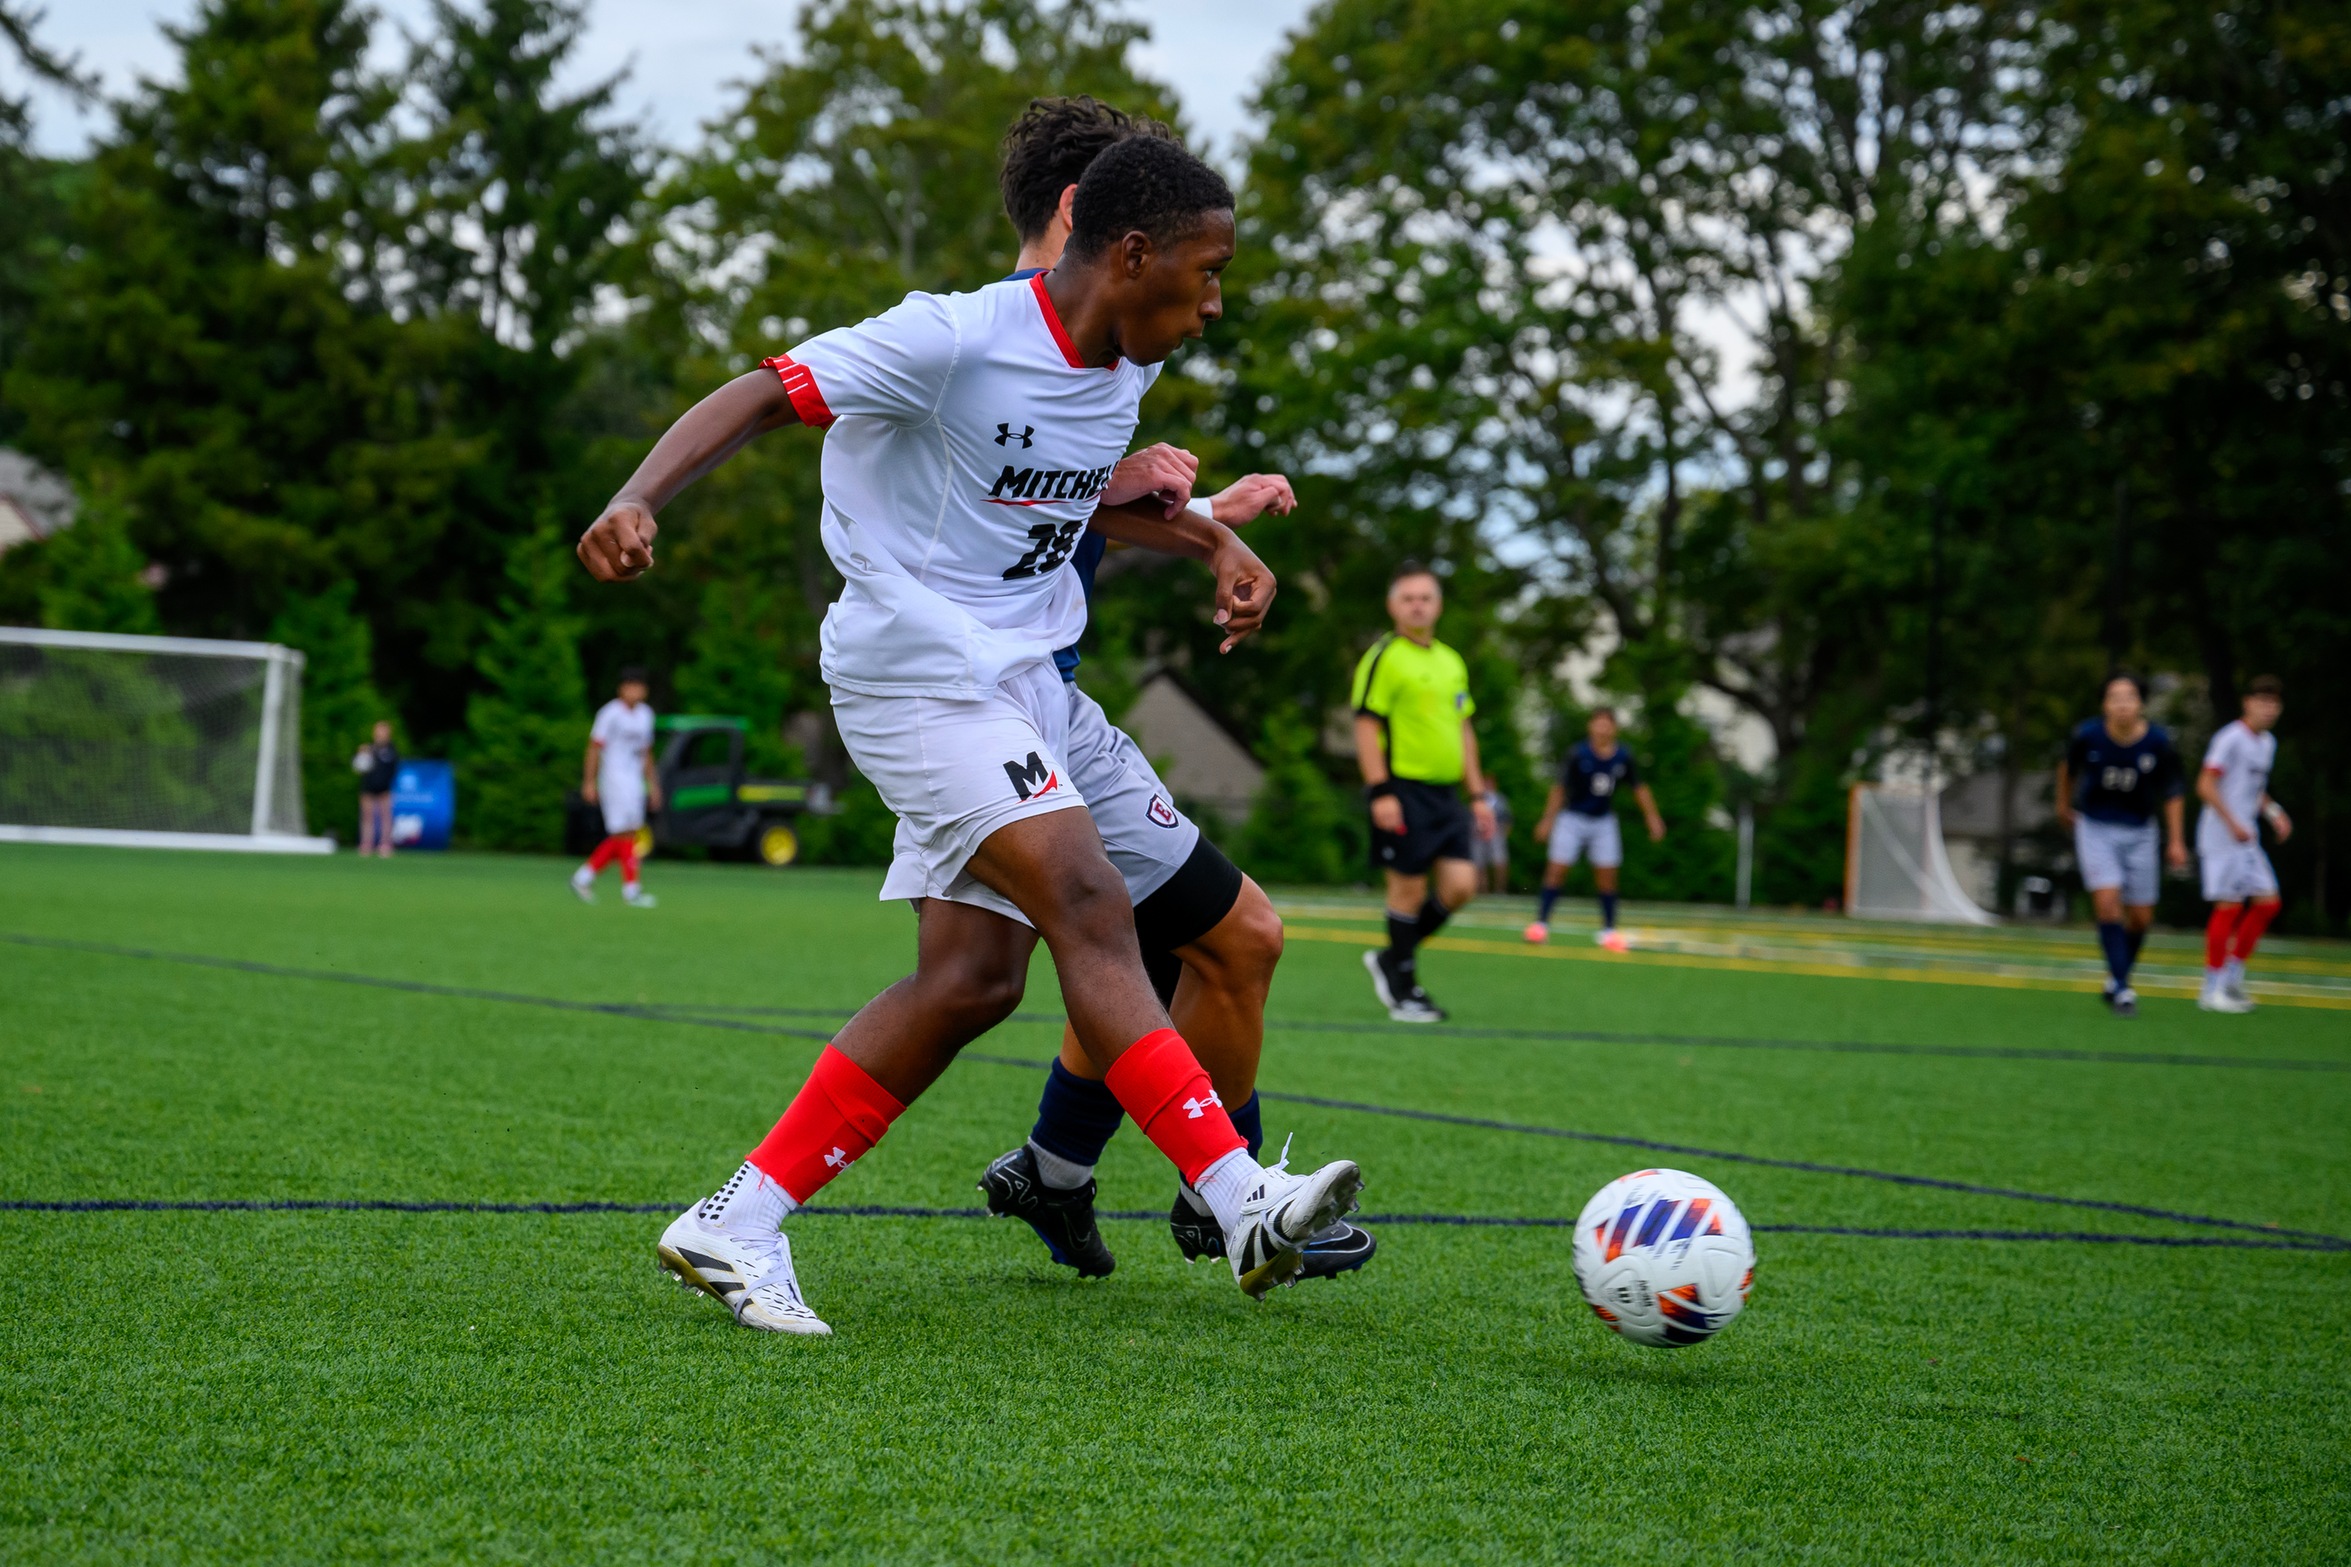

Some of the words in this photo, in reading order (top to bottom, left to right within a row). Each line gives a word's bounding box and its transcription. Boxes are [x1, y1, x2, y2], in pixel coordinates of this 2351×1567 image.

[1001, 520, 1083, 581] 28
[1003, 751, 1048, 800] M
[1154, 801, 1172, 822] E
